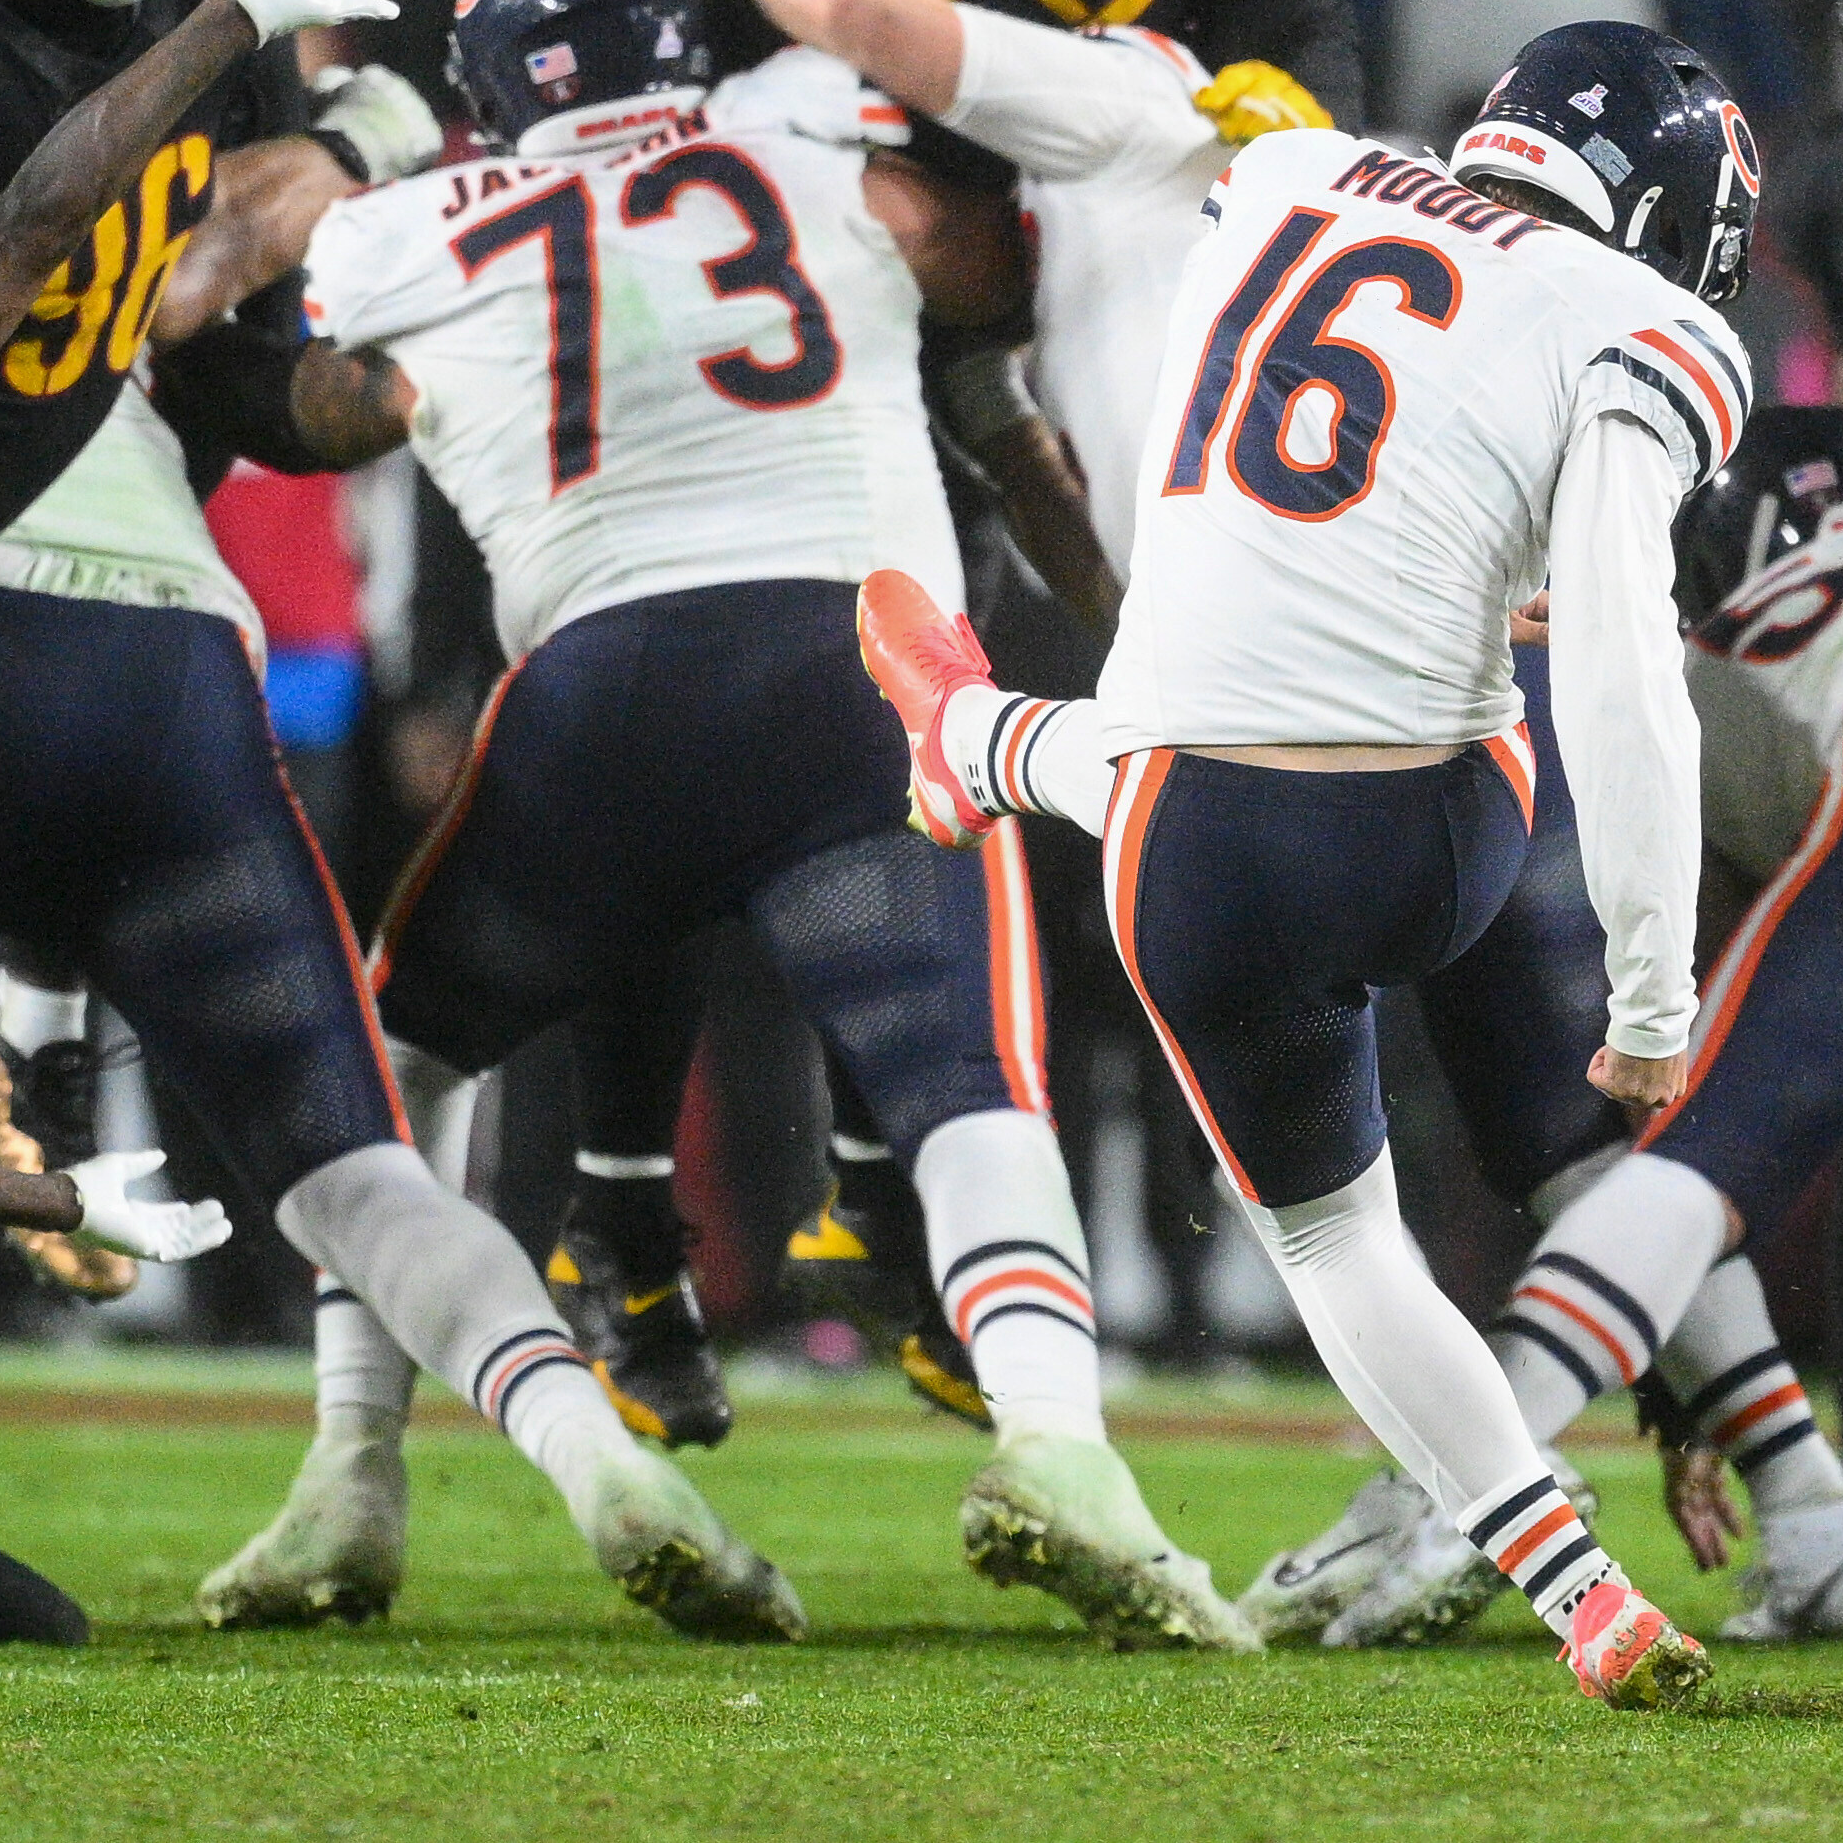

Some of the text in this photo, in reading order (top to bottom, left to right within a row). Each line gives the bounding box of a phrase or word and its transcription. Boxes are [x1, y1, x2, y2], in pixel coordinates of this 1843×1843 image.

[1462, 131, 1547, 166] BEARS
[1573, 93, 1602, 114] CATCH
[1329, 149, 1562, 252] MOODY
[448, 142, 846, 502] 73
[1160, 204, 1464, 524] 16
